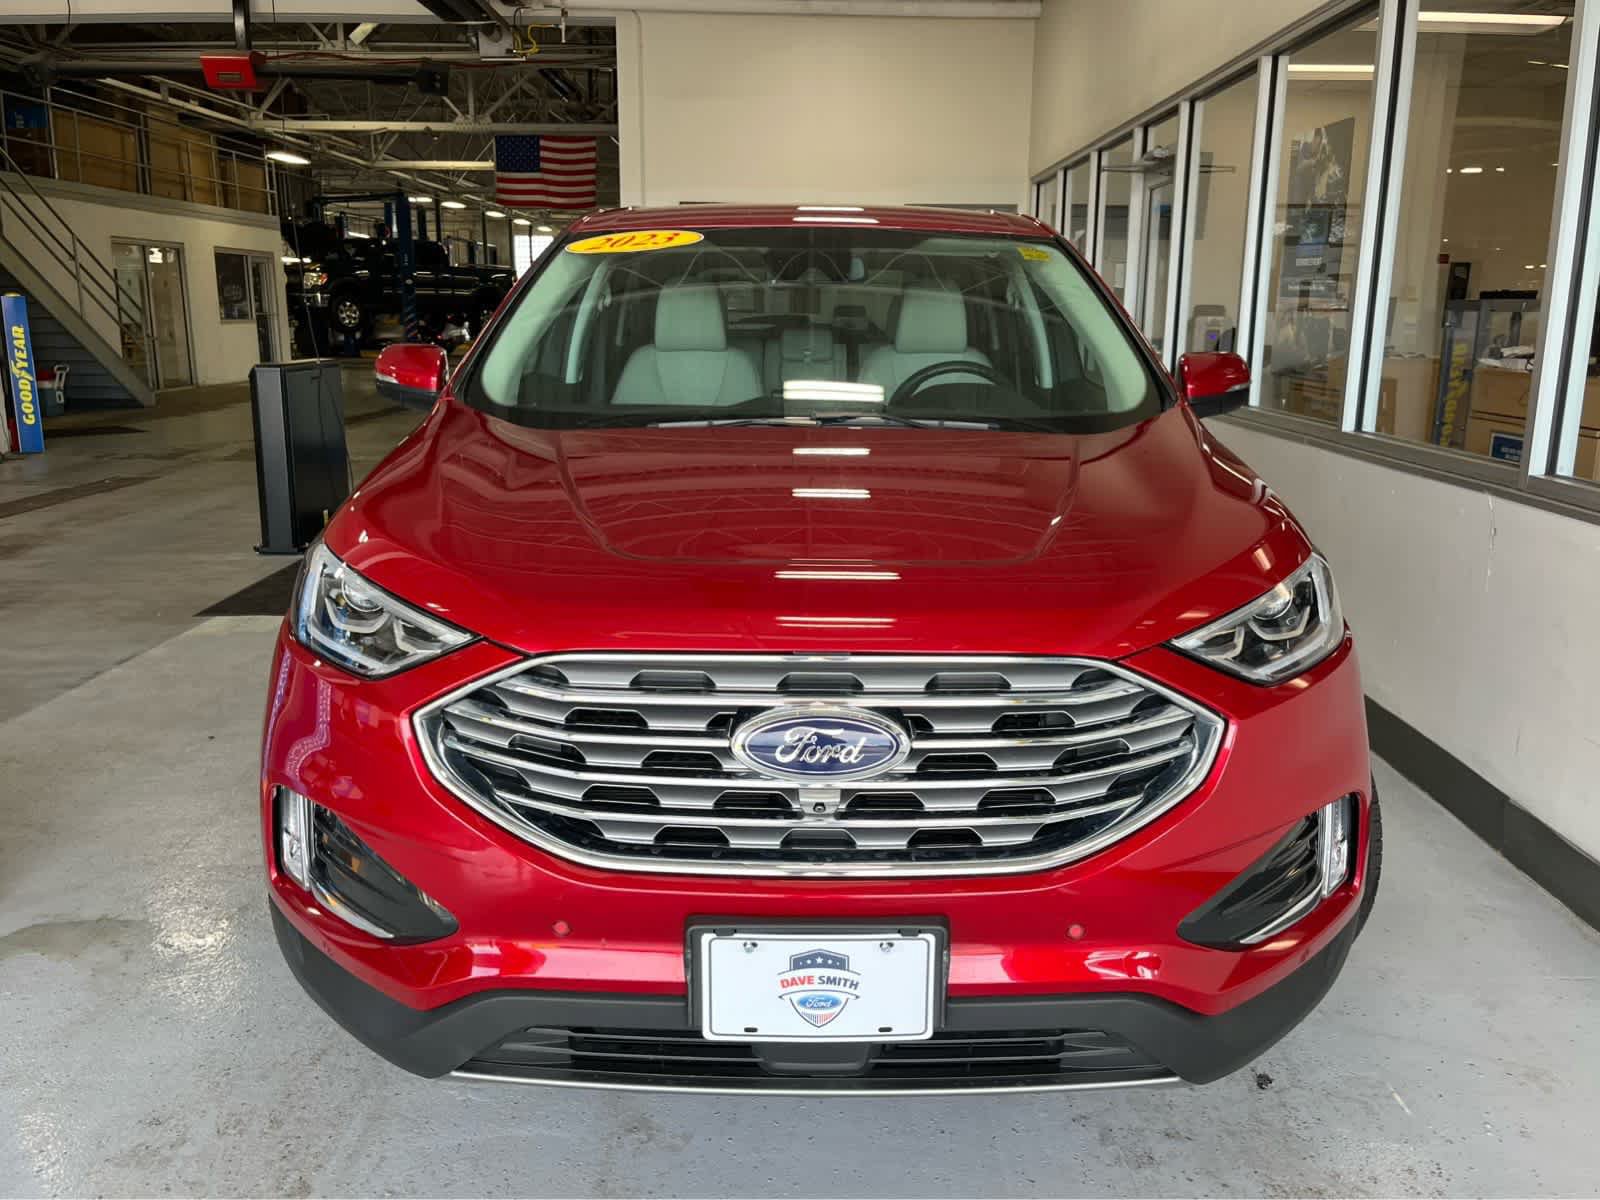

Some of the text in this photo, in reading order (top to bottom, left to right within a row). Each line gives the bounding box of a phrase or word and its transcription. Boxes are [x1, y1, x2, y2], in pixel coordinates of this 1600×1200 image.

[585, 231, 681, 251] 2023
[11, 325, 36, 425] GOODYEAR
[775, 726, 867, 764] Ford
[780, 975, 860, 990] DAVE SMITH
[805, 997, 833, 1009] Ford
